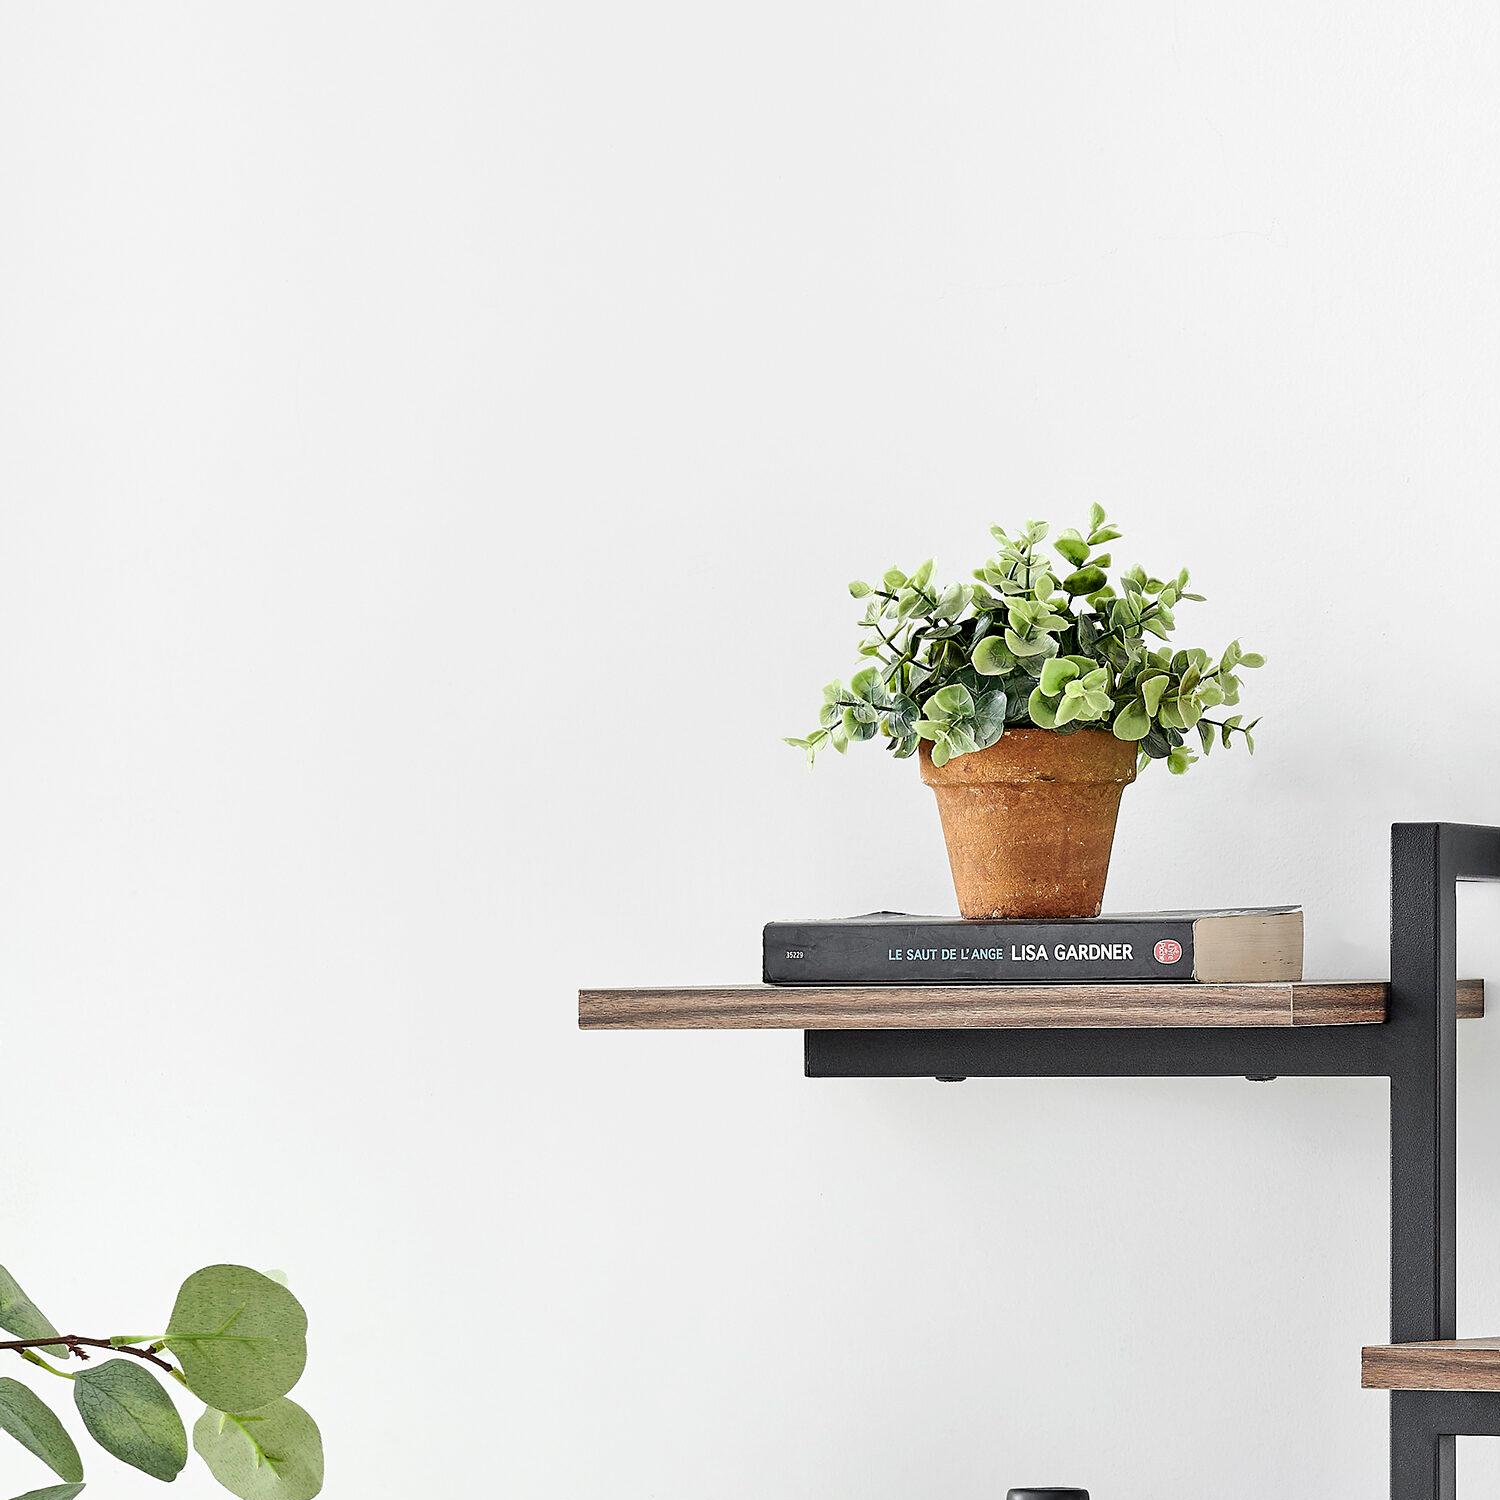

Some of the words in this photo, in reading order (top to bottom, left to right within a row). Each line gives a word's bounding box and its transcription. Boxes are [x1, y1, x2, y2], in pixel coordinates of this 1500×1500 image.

[785, 951, 804, 959] 35229
[888, 949, 903, 961] LE
[906, 949, 938, 961] SAUT
[941, 949, 957, 961] DE
[961, 948, 1004, 960] L'ANGE
[1011, 944, 1049, 961] LISA
[1054, 943, 1134, 961] GARDNER
